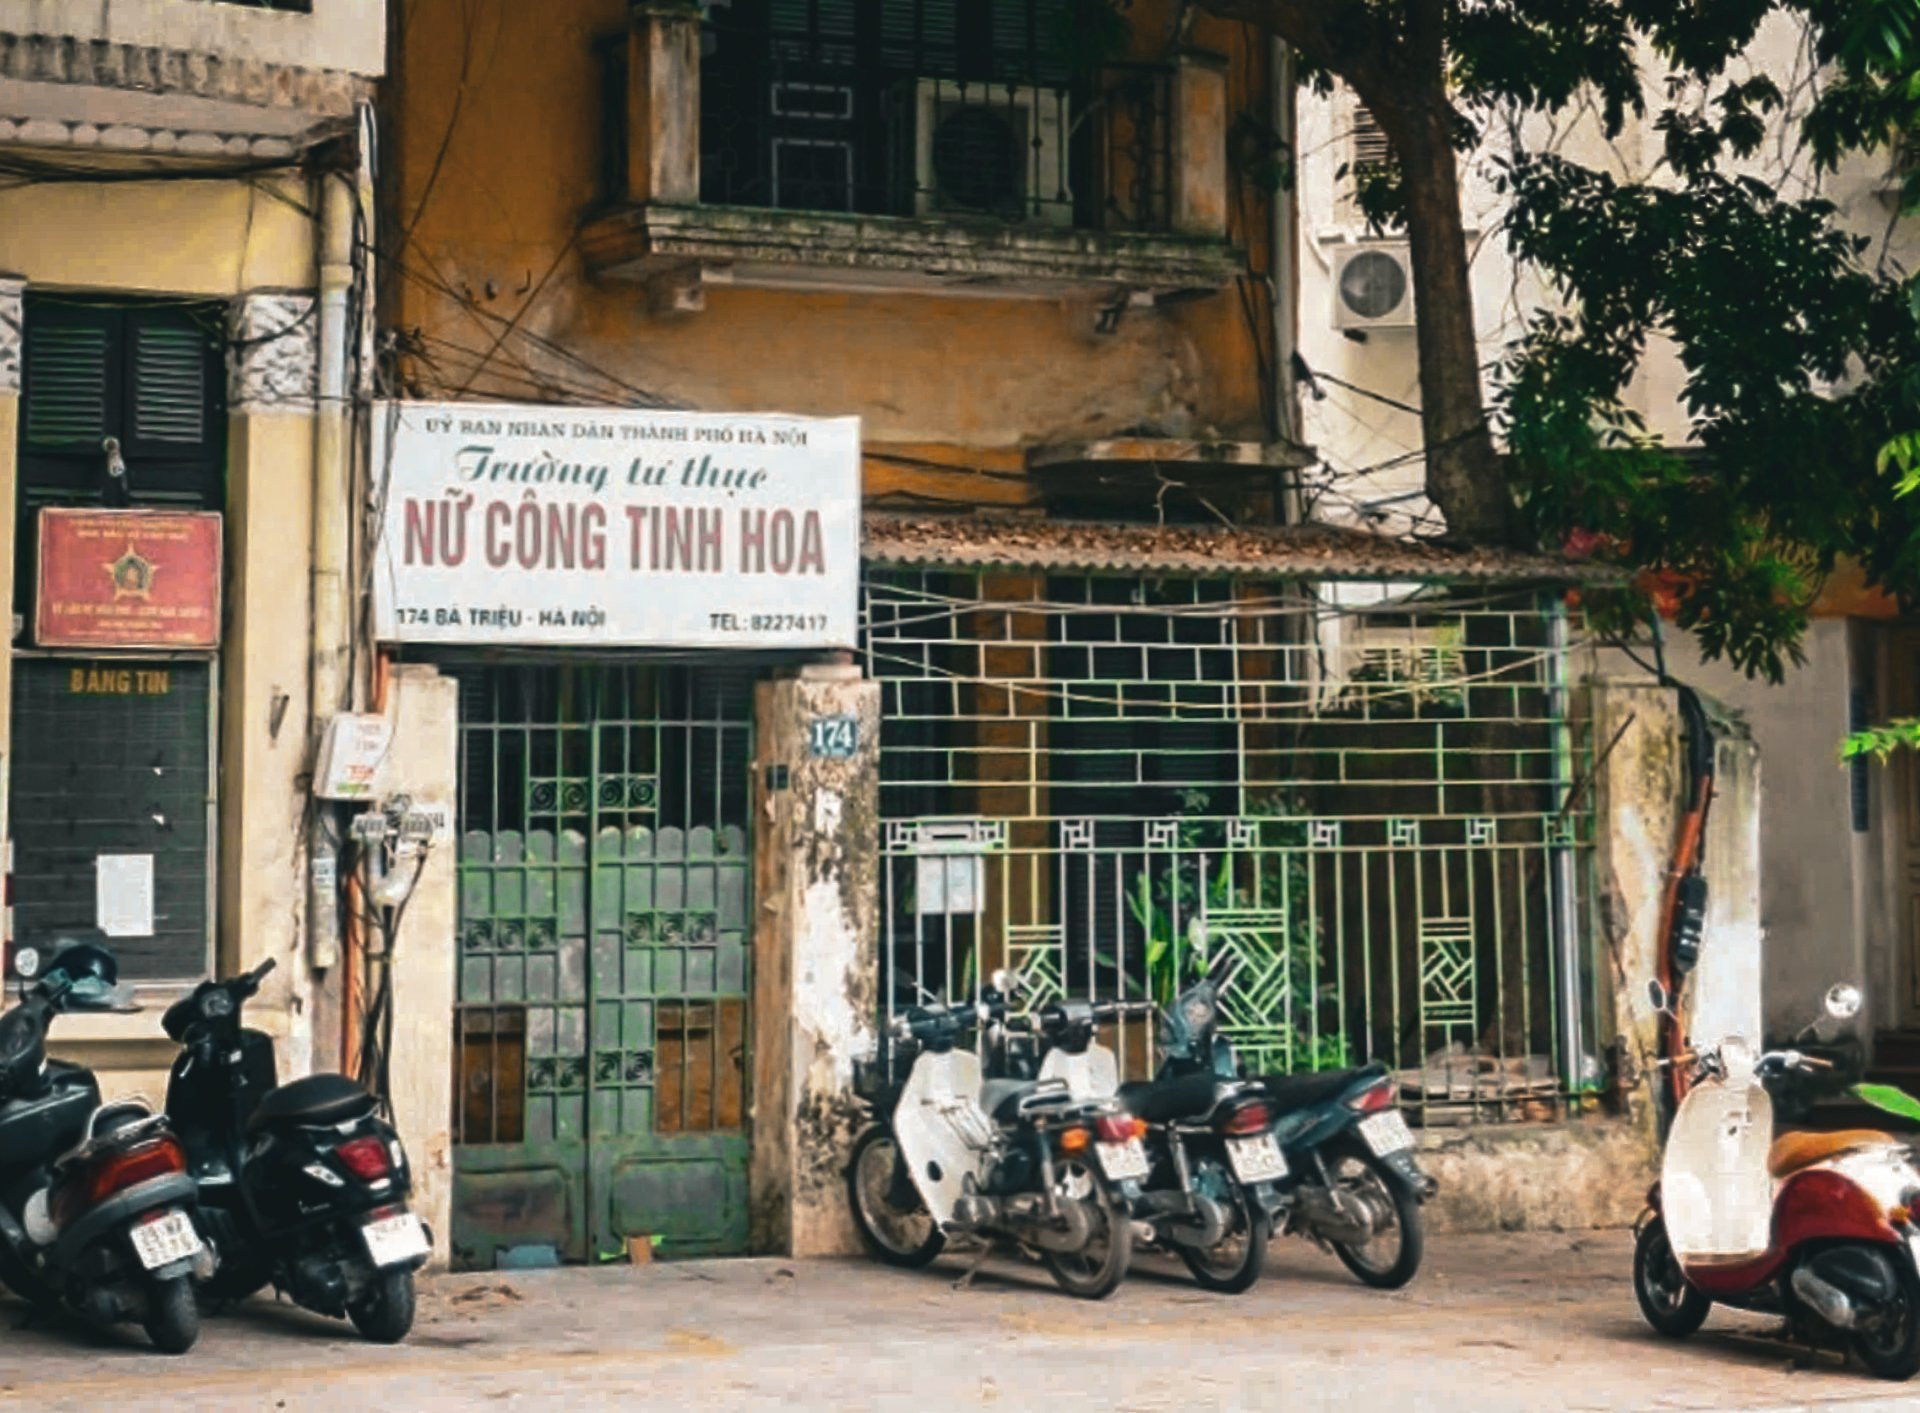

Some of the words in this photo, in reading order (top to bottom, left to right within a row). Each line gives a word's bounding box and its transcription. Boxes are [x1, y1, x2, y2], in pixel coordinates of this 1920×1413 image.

[461, 419, 502, 436] BAN
[456, 445, 609, 493] Trường
[404, 487, 475, 566] NỮ
[485, 487, 607, 570] CÔNG
[625, 505, 723, 573] TINH
[740, 508, 826, 575] HOA
[397, 607, 430, 625] 174
[136, 671, 170, 695] TIN
[813, 721, 853, 749] 174
